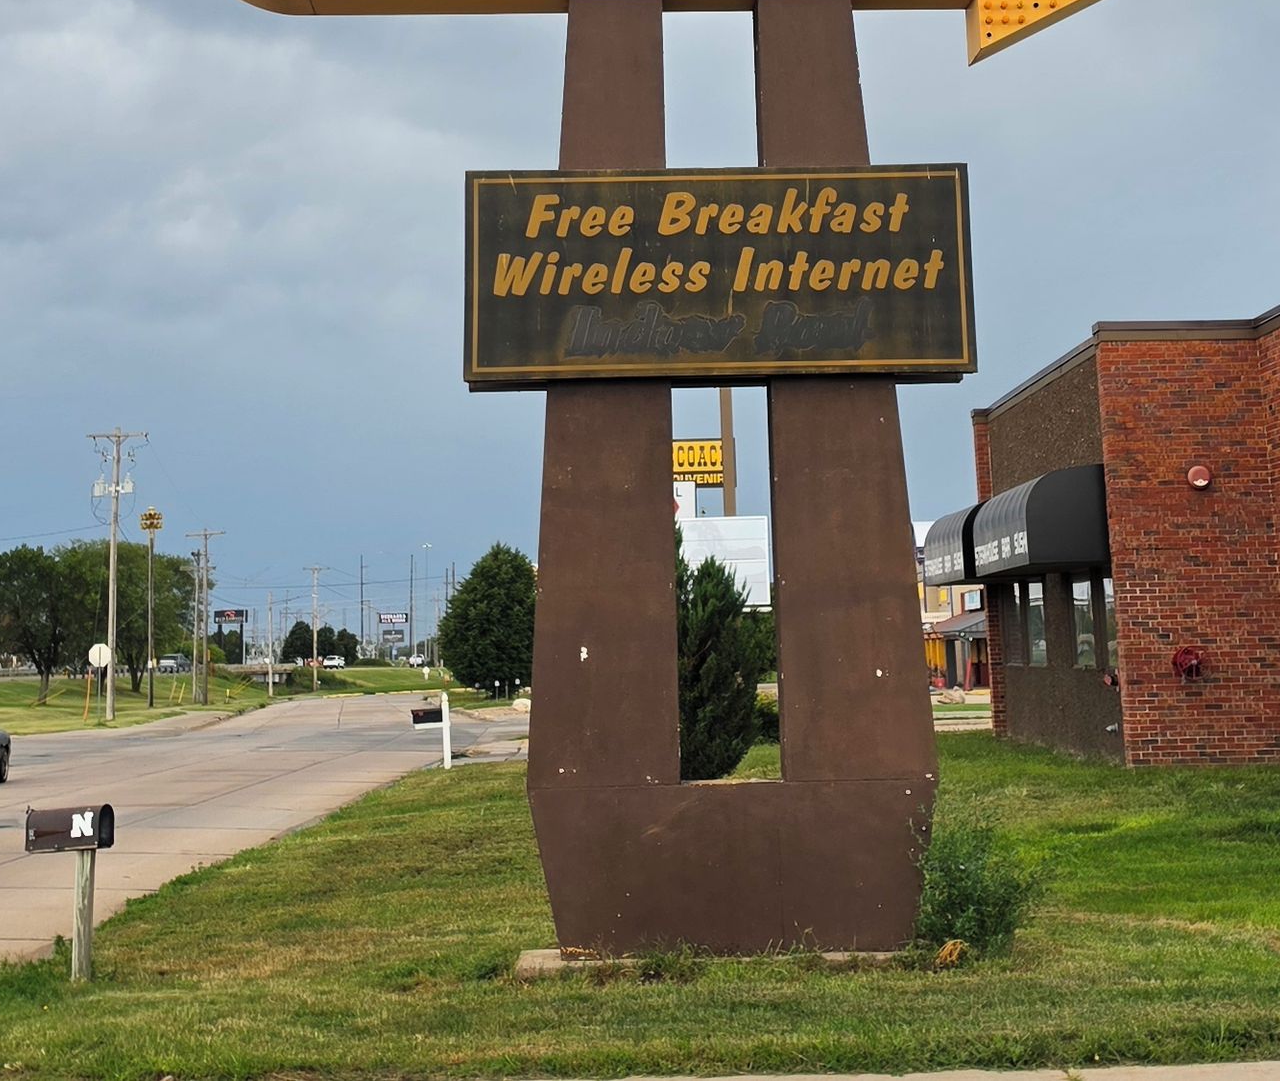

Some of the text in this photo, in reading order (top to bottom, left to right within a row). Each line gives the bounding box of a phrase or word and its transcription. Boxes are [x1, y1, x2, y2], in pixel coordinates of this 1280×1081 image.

[525, 187, 910, 239] Free Breakfast
[493, 246, 945, 297] Wireless Internet
[677, 445, 723, 467] COAC
[70, 811, 94, 838] N
